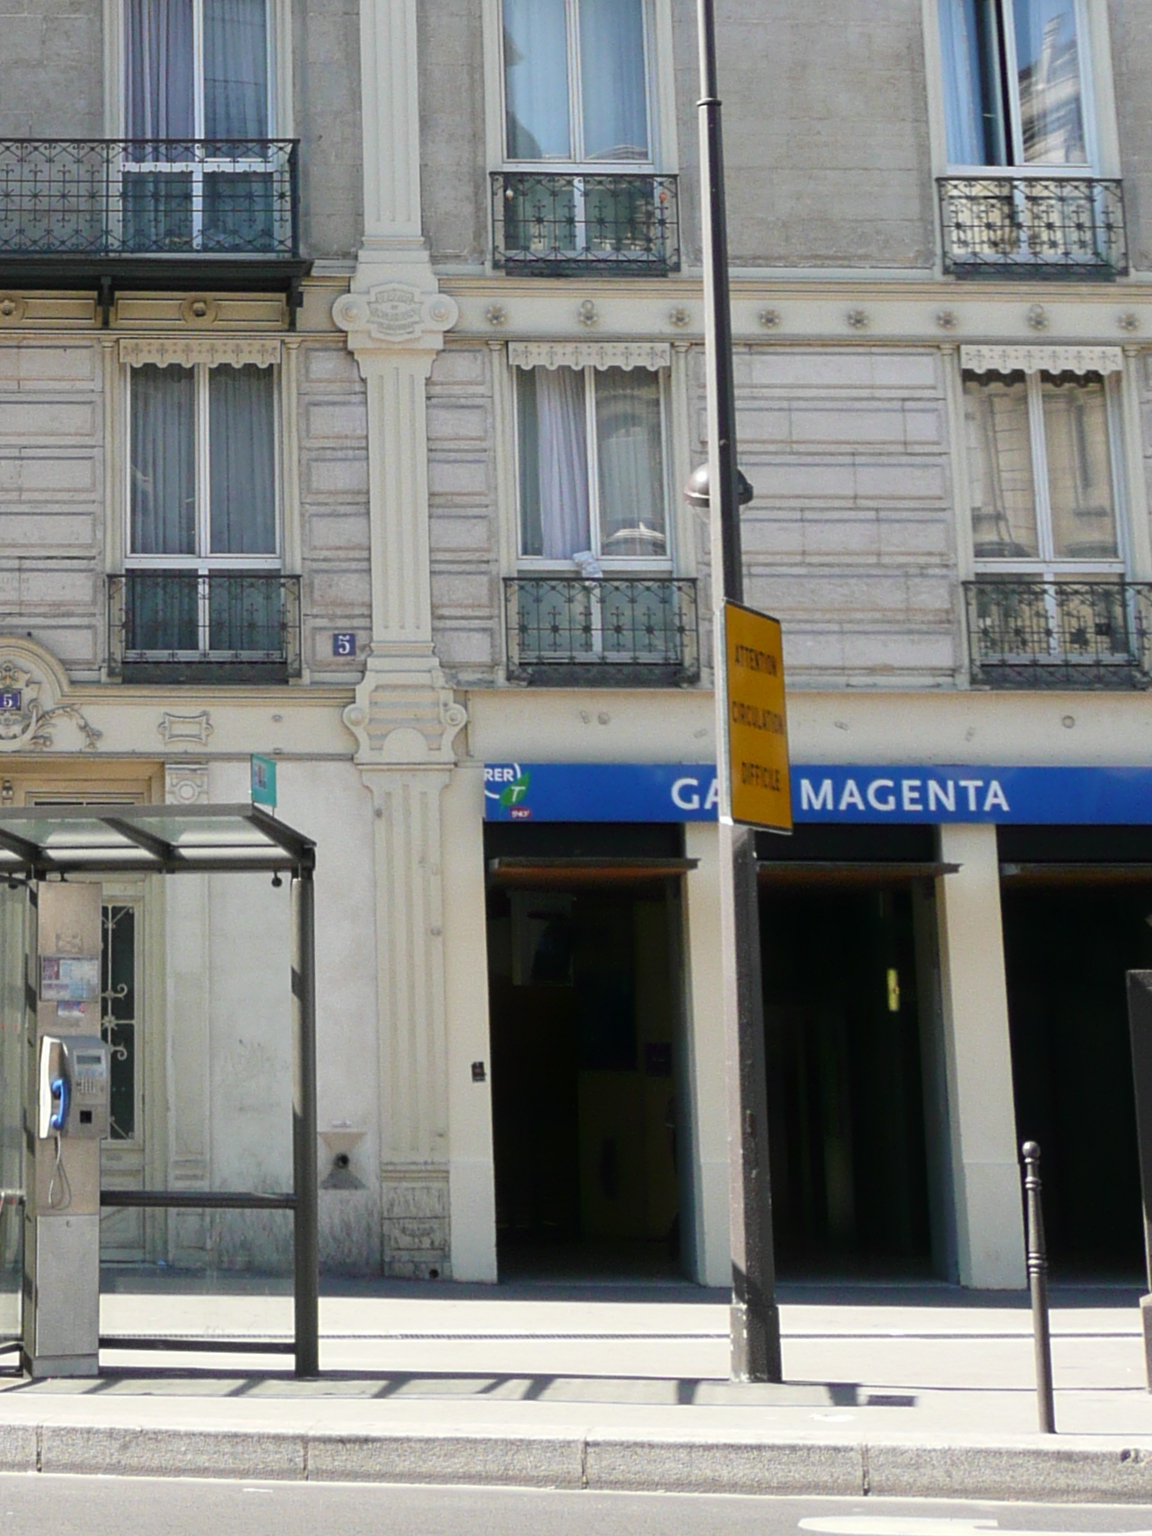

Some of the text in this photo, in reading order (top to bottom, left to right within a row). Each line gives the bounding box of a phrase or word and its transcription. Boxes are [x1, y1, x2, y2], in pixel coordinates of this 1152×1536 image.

[338, 635, 351, 654] 5
[735, 644, 777, 677] ATTENTION
[3, 694, 14, 708] 5
[731, 700, 784, 735] CIRCULATION
[485, 768, 514, 782] RER
[741, 761, 781, 793] DIFFICILE
[800, 778, 1010, 811] MAGENTA
